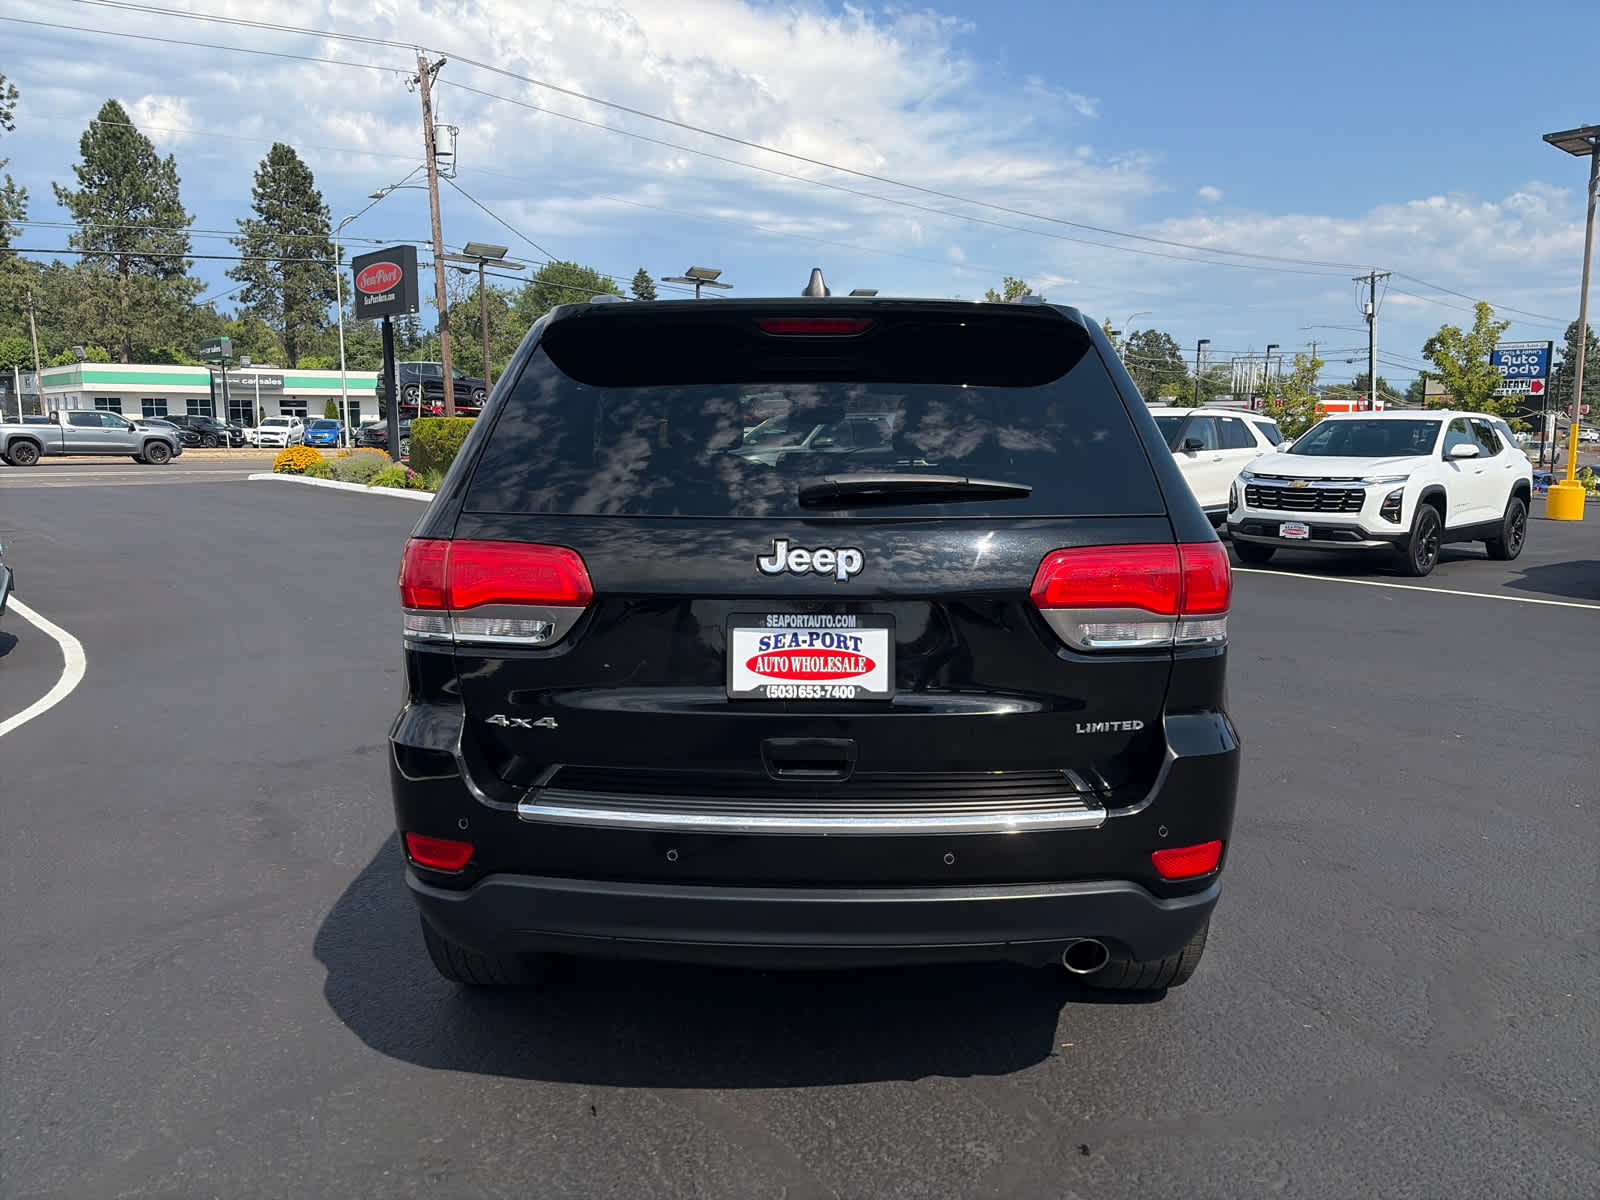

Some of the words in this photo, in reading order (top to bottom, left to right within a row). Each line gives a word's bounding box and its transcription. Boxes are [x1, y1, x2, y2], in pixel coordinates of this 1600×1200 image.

[1501, 355, 1538, 366] Auto
[1499, 365, 1540, 376] Body
[259, 377, 282, 385] sales
[758, 540, 863, 581] Jeep
[766, 614, 856, 628] SEAPORTAUTO.COM
[758, 631, 862, 652] SEA-PORT
[755, 656, 789, 673] AUTO
[790, 656, 867, 673] WHOLESALE
[484, 714, 559, 729] 4x4
[1075, 720, 1145, 733] LIMITED
